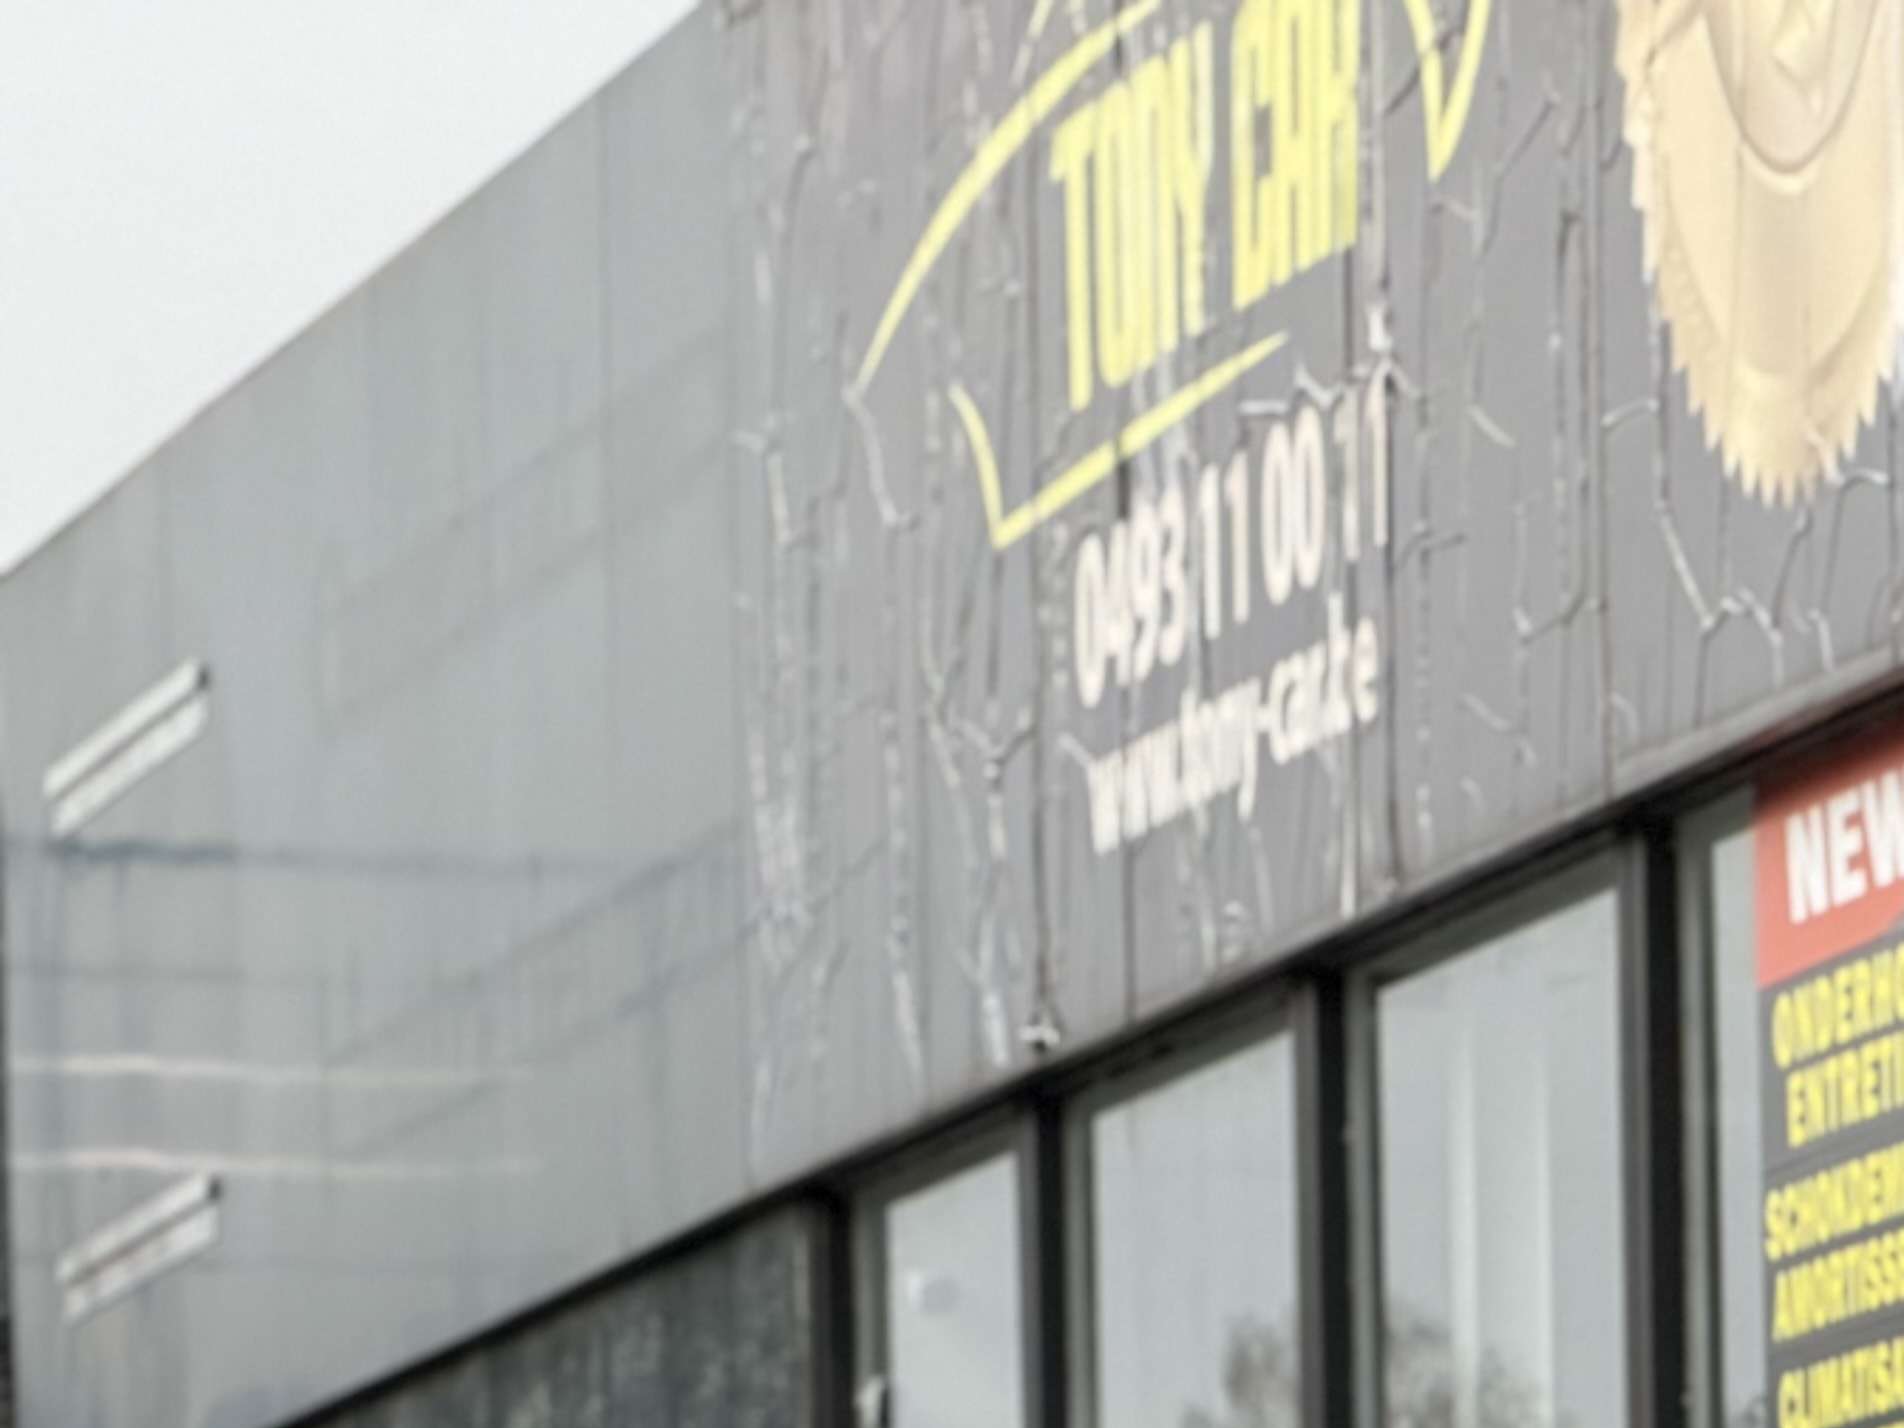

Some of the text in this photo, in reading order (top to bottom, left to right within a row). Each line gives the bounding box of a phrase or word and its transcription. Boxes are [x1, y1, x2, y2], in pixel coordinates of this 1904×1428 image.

[1050, 0, 1360, 412] TONY CAR
[1199, 450, 1250, 640] 11
[1261, 405, 1326, 606] 00
[1333, 368, 1389, 563] 11
